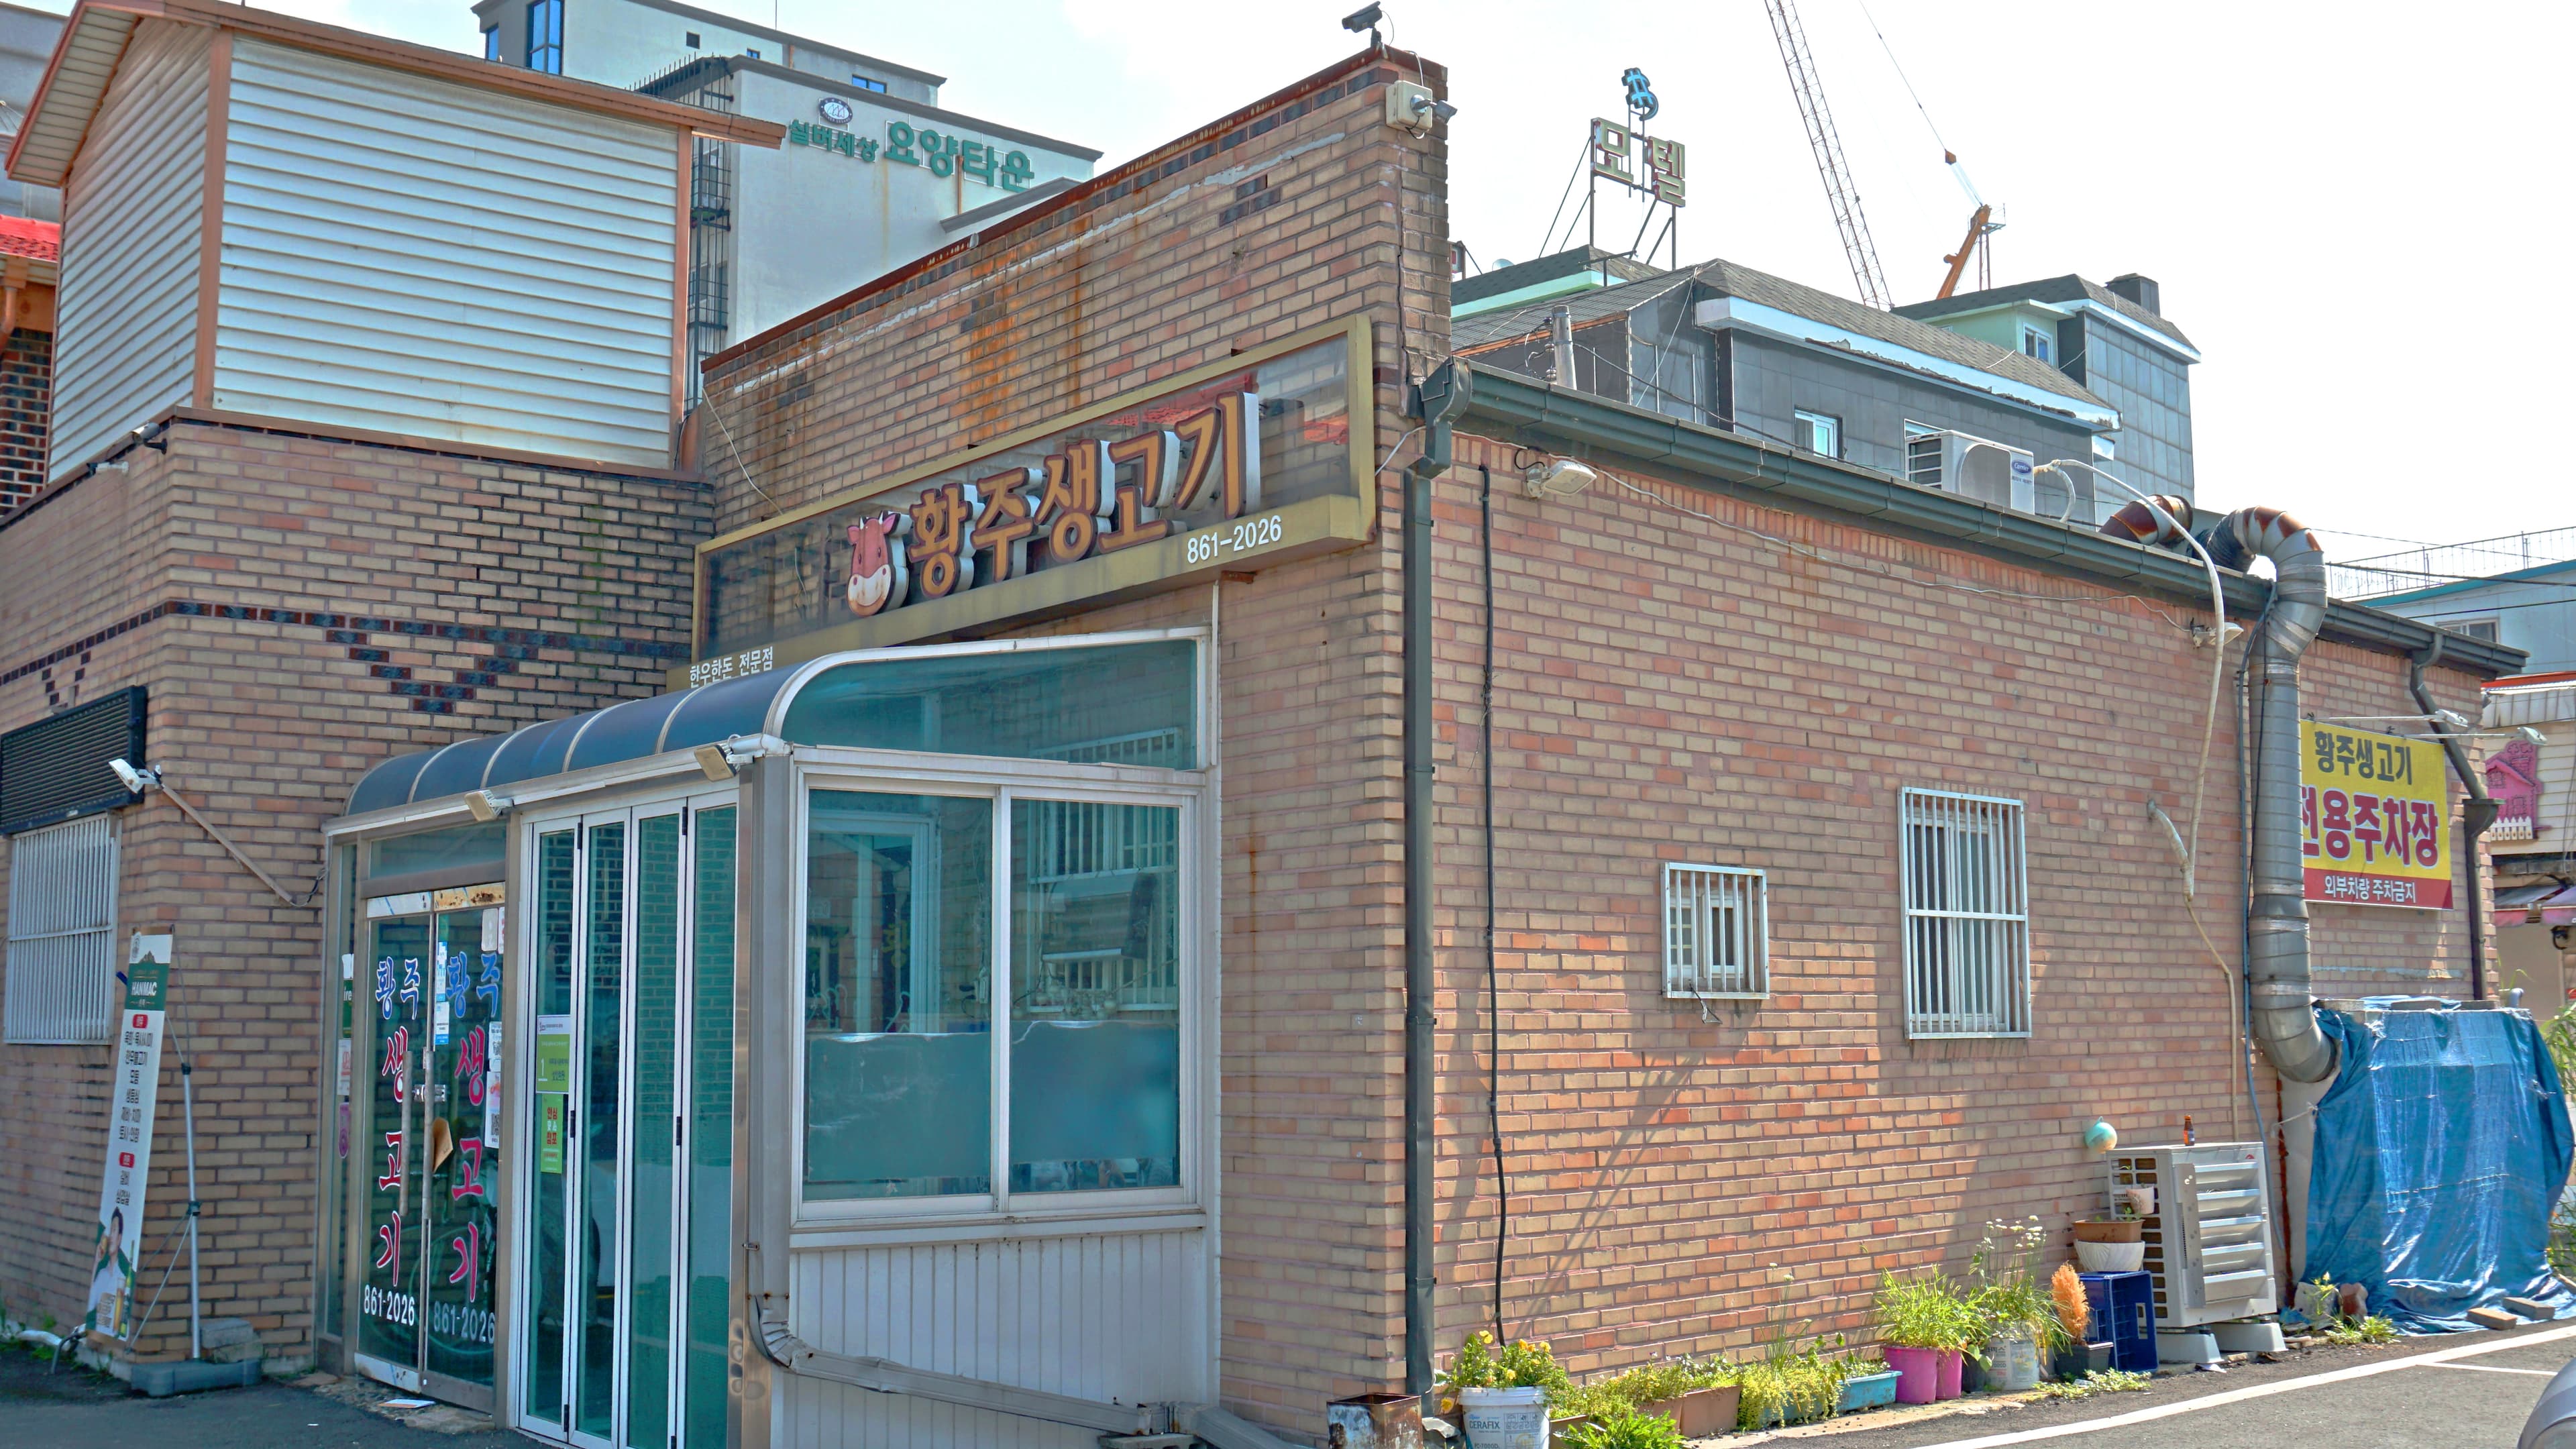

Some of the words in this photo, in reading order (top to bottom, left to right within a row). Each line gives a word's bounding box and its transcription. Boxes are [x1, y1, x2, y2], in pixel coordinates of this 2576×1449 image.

[789, 119, 879, 163] 실버세상
[885, 121, 1035, 193] 요양타운
[1591, 117, 1686, 208] 모텔
[2014, 462, 2029, 472] Carrier
[908, 390, 1260, 598] 황주생고기
[1187, 515, 1283, 564] 861-2026
[739, 646, 773, 677] 전문점
[2314, 731, 2412, 786] 황주생고기
[2324, 875, 2369, 899] 외부차량
[2372, 878, 2416, 904] 주차금지
[131, 981, 158, 996] HANMAC
[375, 956, 421, 1020] 황주
[445, 951, 500, 1018] 황주
[364, 1284, 415, 1326] 861-2026
[433, 1300, 496, 1344] 861-2026
[1469, 1420, 1501, 1430] CERAFIX
